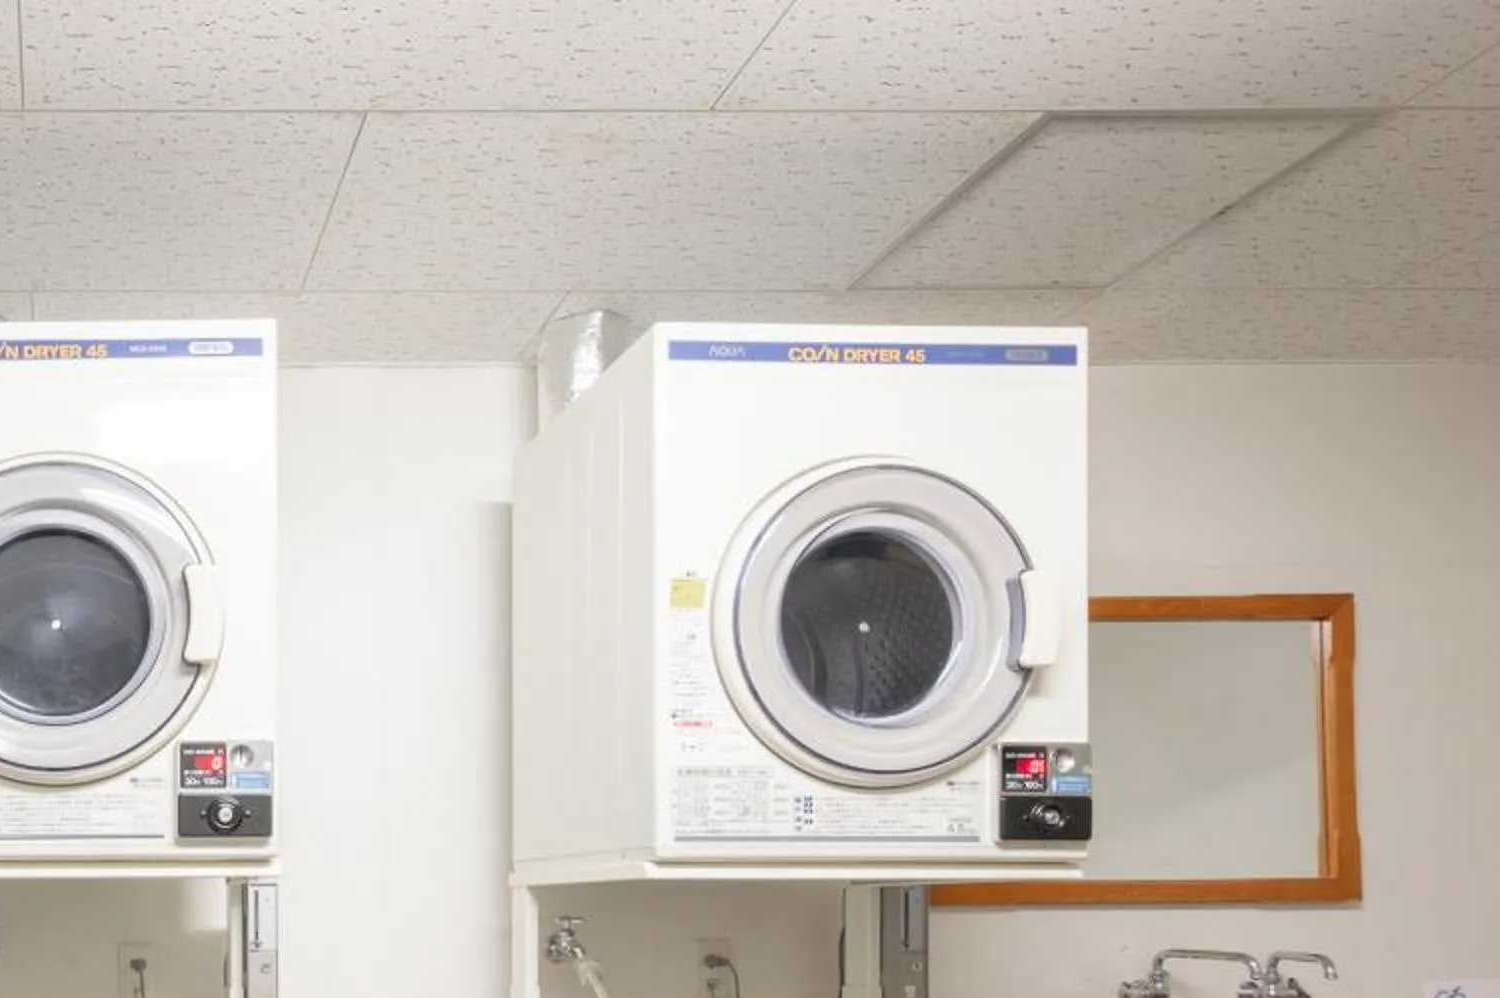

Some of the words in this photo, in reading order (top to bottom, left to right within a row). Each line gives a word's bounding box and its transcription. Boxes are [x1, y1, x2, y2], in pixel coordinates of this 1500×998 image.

[23, 345, 82, 359] DRYER
[85, 344, 108, 358] 45
[708, 345, 746, 358] AQUA
[843, 349, 901, 363] DRYER
[905, 350, 926, 363] 45
